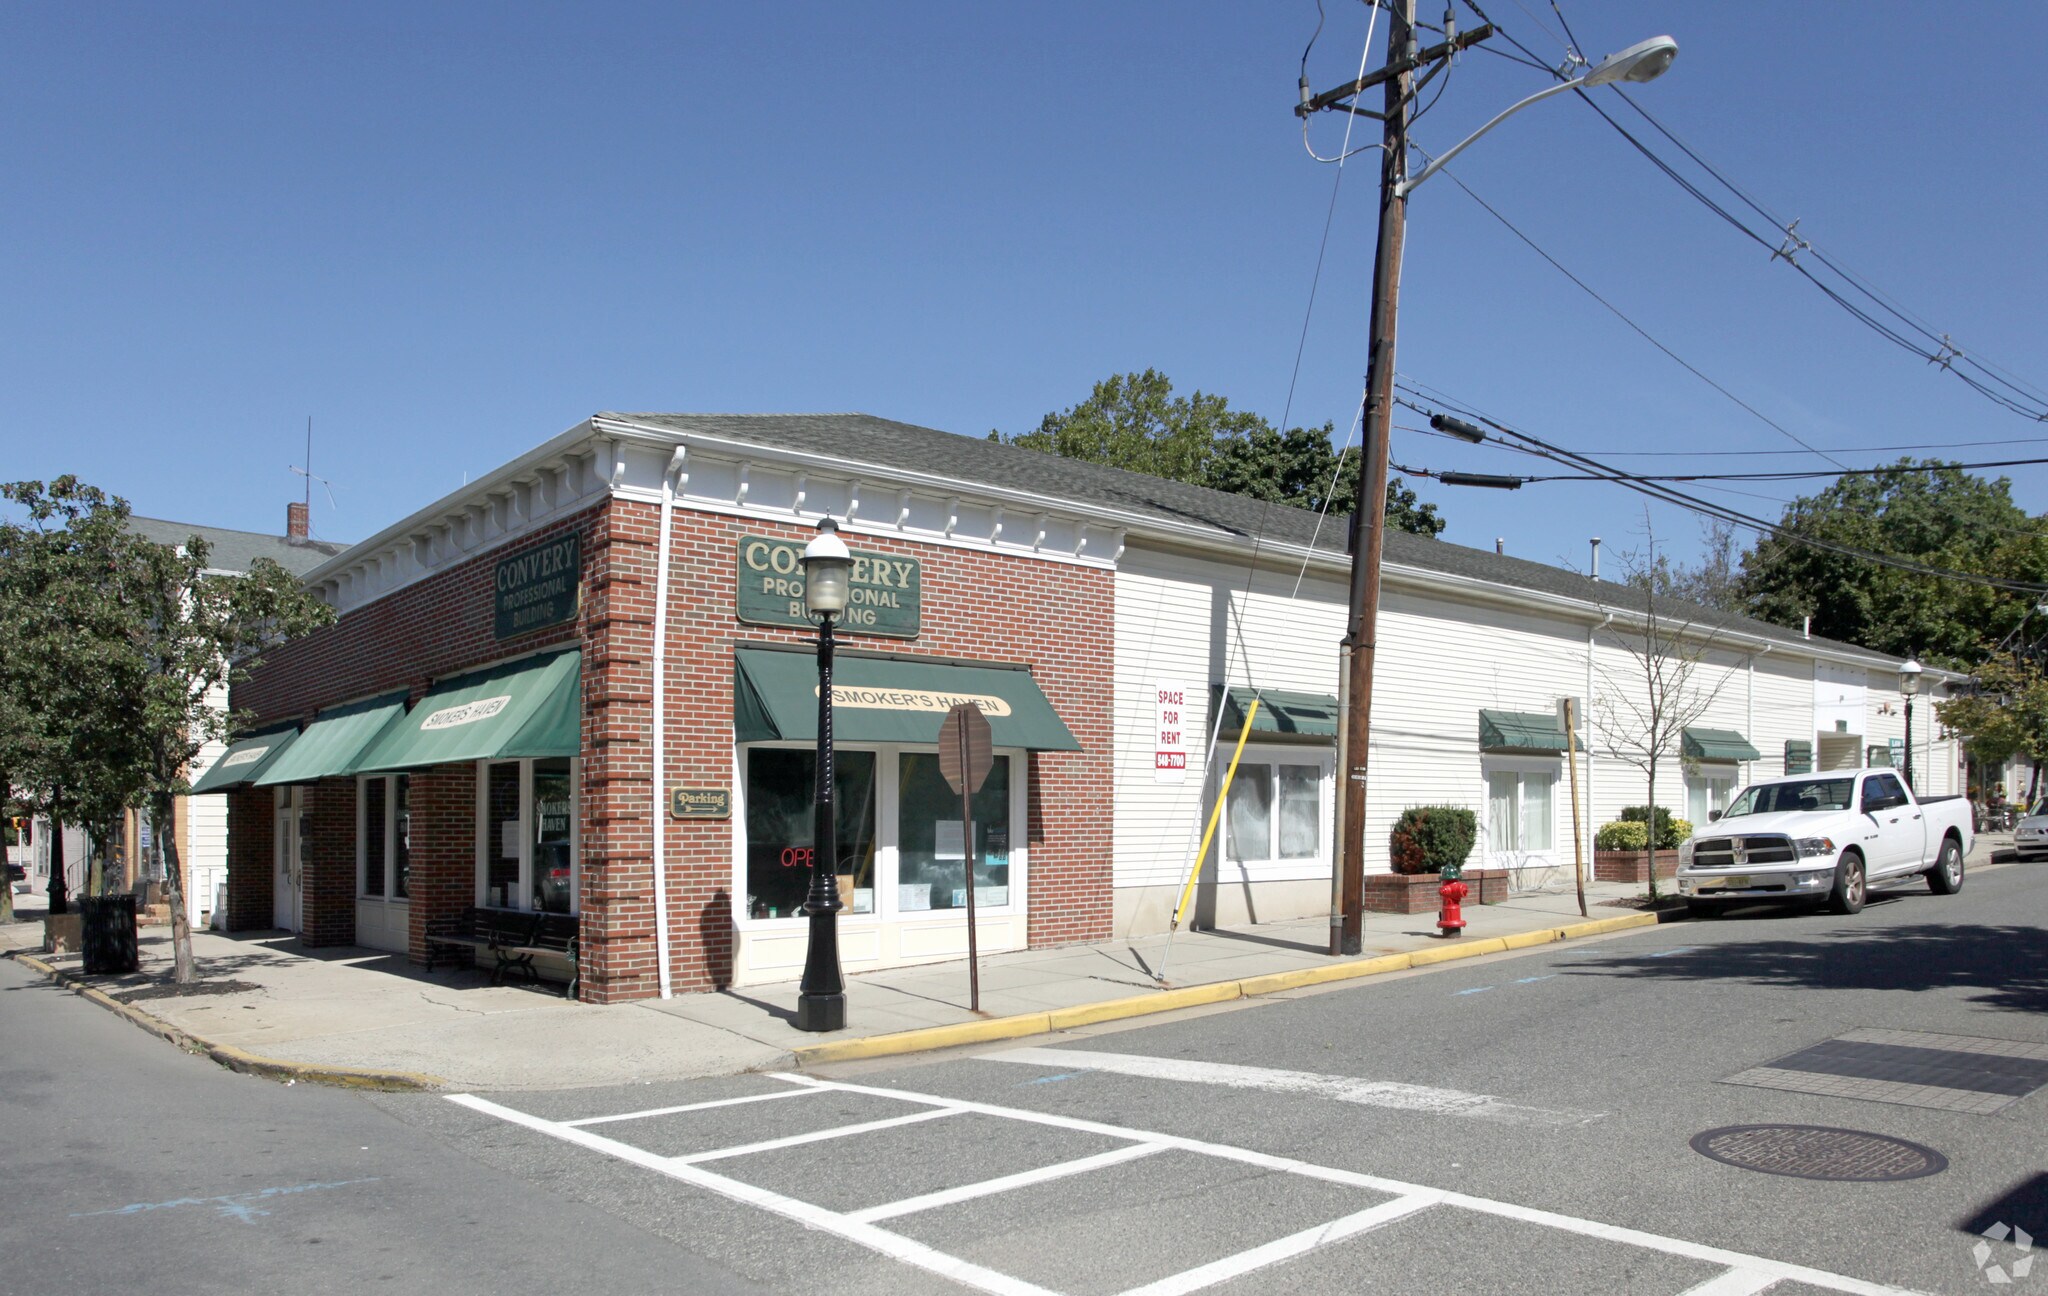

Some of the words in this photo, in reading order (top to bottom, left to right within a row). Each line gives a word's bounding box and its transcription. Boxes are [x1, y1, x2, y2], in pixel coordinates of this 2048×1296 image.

[498, 538, 576, 592] CONVERY
[746, 542, 914, 588] COERY
[503, 576, 567, 611] PROFESSIONAL
[763, 577, 900, 608] PROIONAL
[513, 601, 554, 627] BUILDING
[832, 690, 933, 707] SMOKER'S
[1158, 690, 1184, 705] SPACE
[1163, 711, 1179, 724] FOR
[1161, 731, 1181, 744] RENT
[678, 792, 725, 806] Parking
[542, 817, 566, 831] HAVEN
[781, 848, 814, 868] OPE
